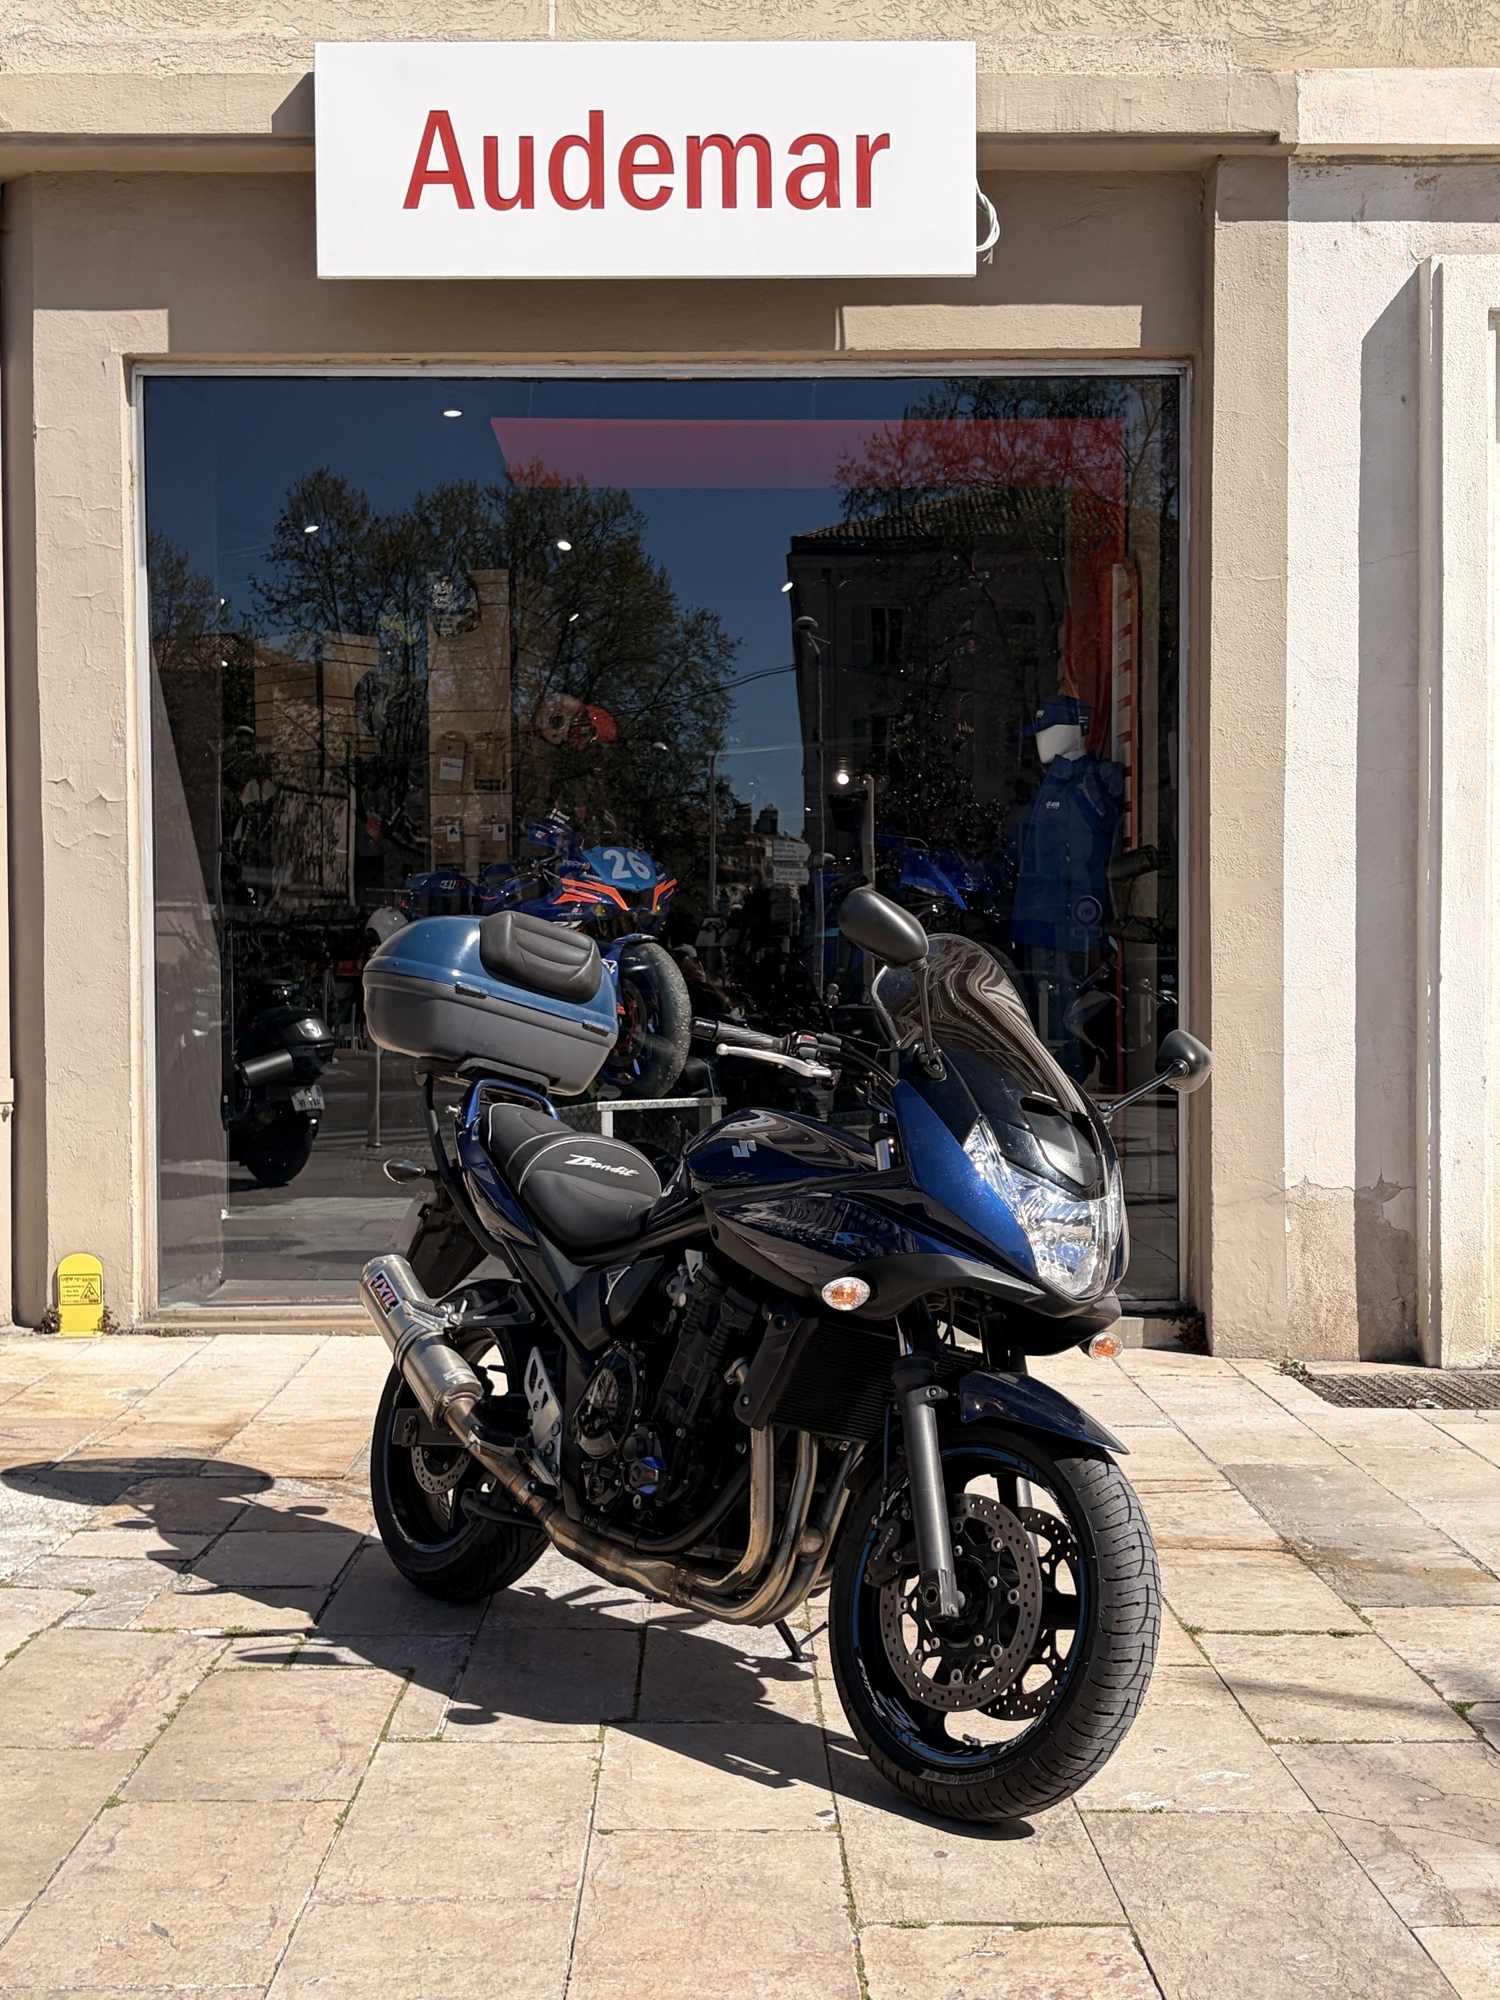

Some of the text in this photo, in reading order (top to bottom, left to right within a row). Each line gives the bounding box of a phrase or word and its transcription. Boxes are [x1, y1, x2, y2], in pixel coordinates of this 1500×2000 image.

[402, 109, 891, 211] Audemar
[603, 849, 652, 881] 26
[564, 1153, 640, 1177] Bandit
